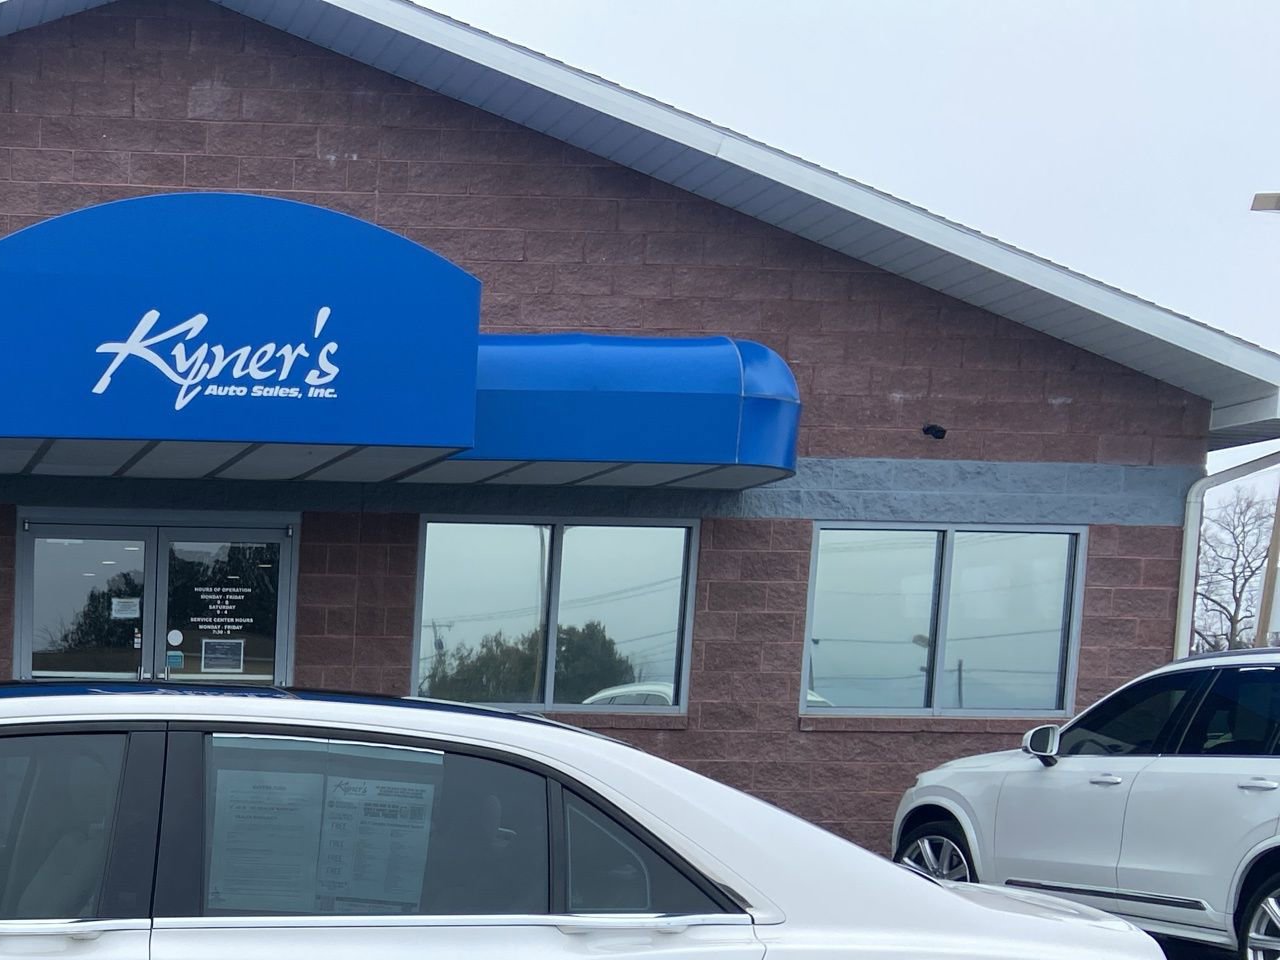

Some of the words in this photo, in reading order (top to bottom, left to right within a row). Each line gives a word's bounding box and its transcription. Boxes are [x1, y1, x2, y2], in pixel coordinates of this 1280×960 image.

[91, 306, 340, 411] Kyner's
[204, 384, 248, 397] Auto
[251, 385, 303, 399] Sales,
[307, 386, 338, 398] Inc.
